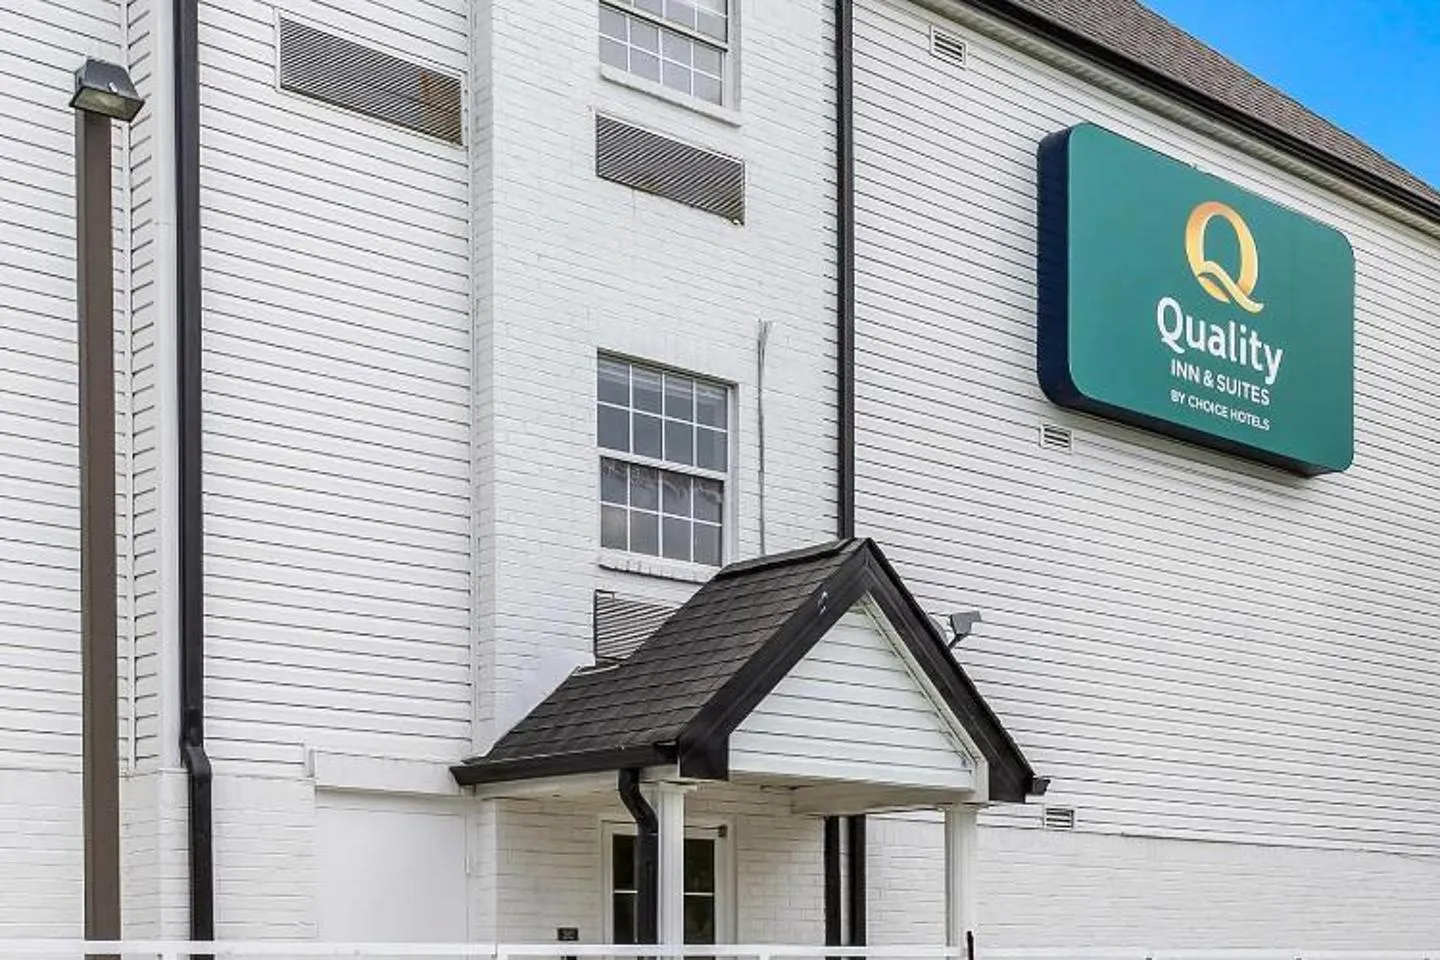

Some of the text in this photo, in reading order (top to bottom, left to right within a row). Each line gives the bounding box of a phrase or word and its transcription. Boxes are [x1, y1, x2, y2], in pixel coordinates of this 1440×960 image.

[1157, 297, 1283, 385] Quality
[1170, 359, 1270, 406] INN & SUITES
[1170, 389, 1270, 431] BY CHOICE HOTELS
